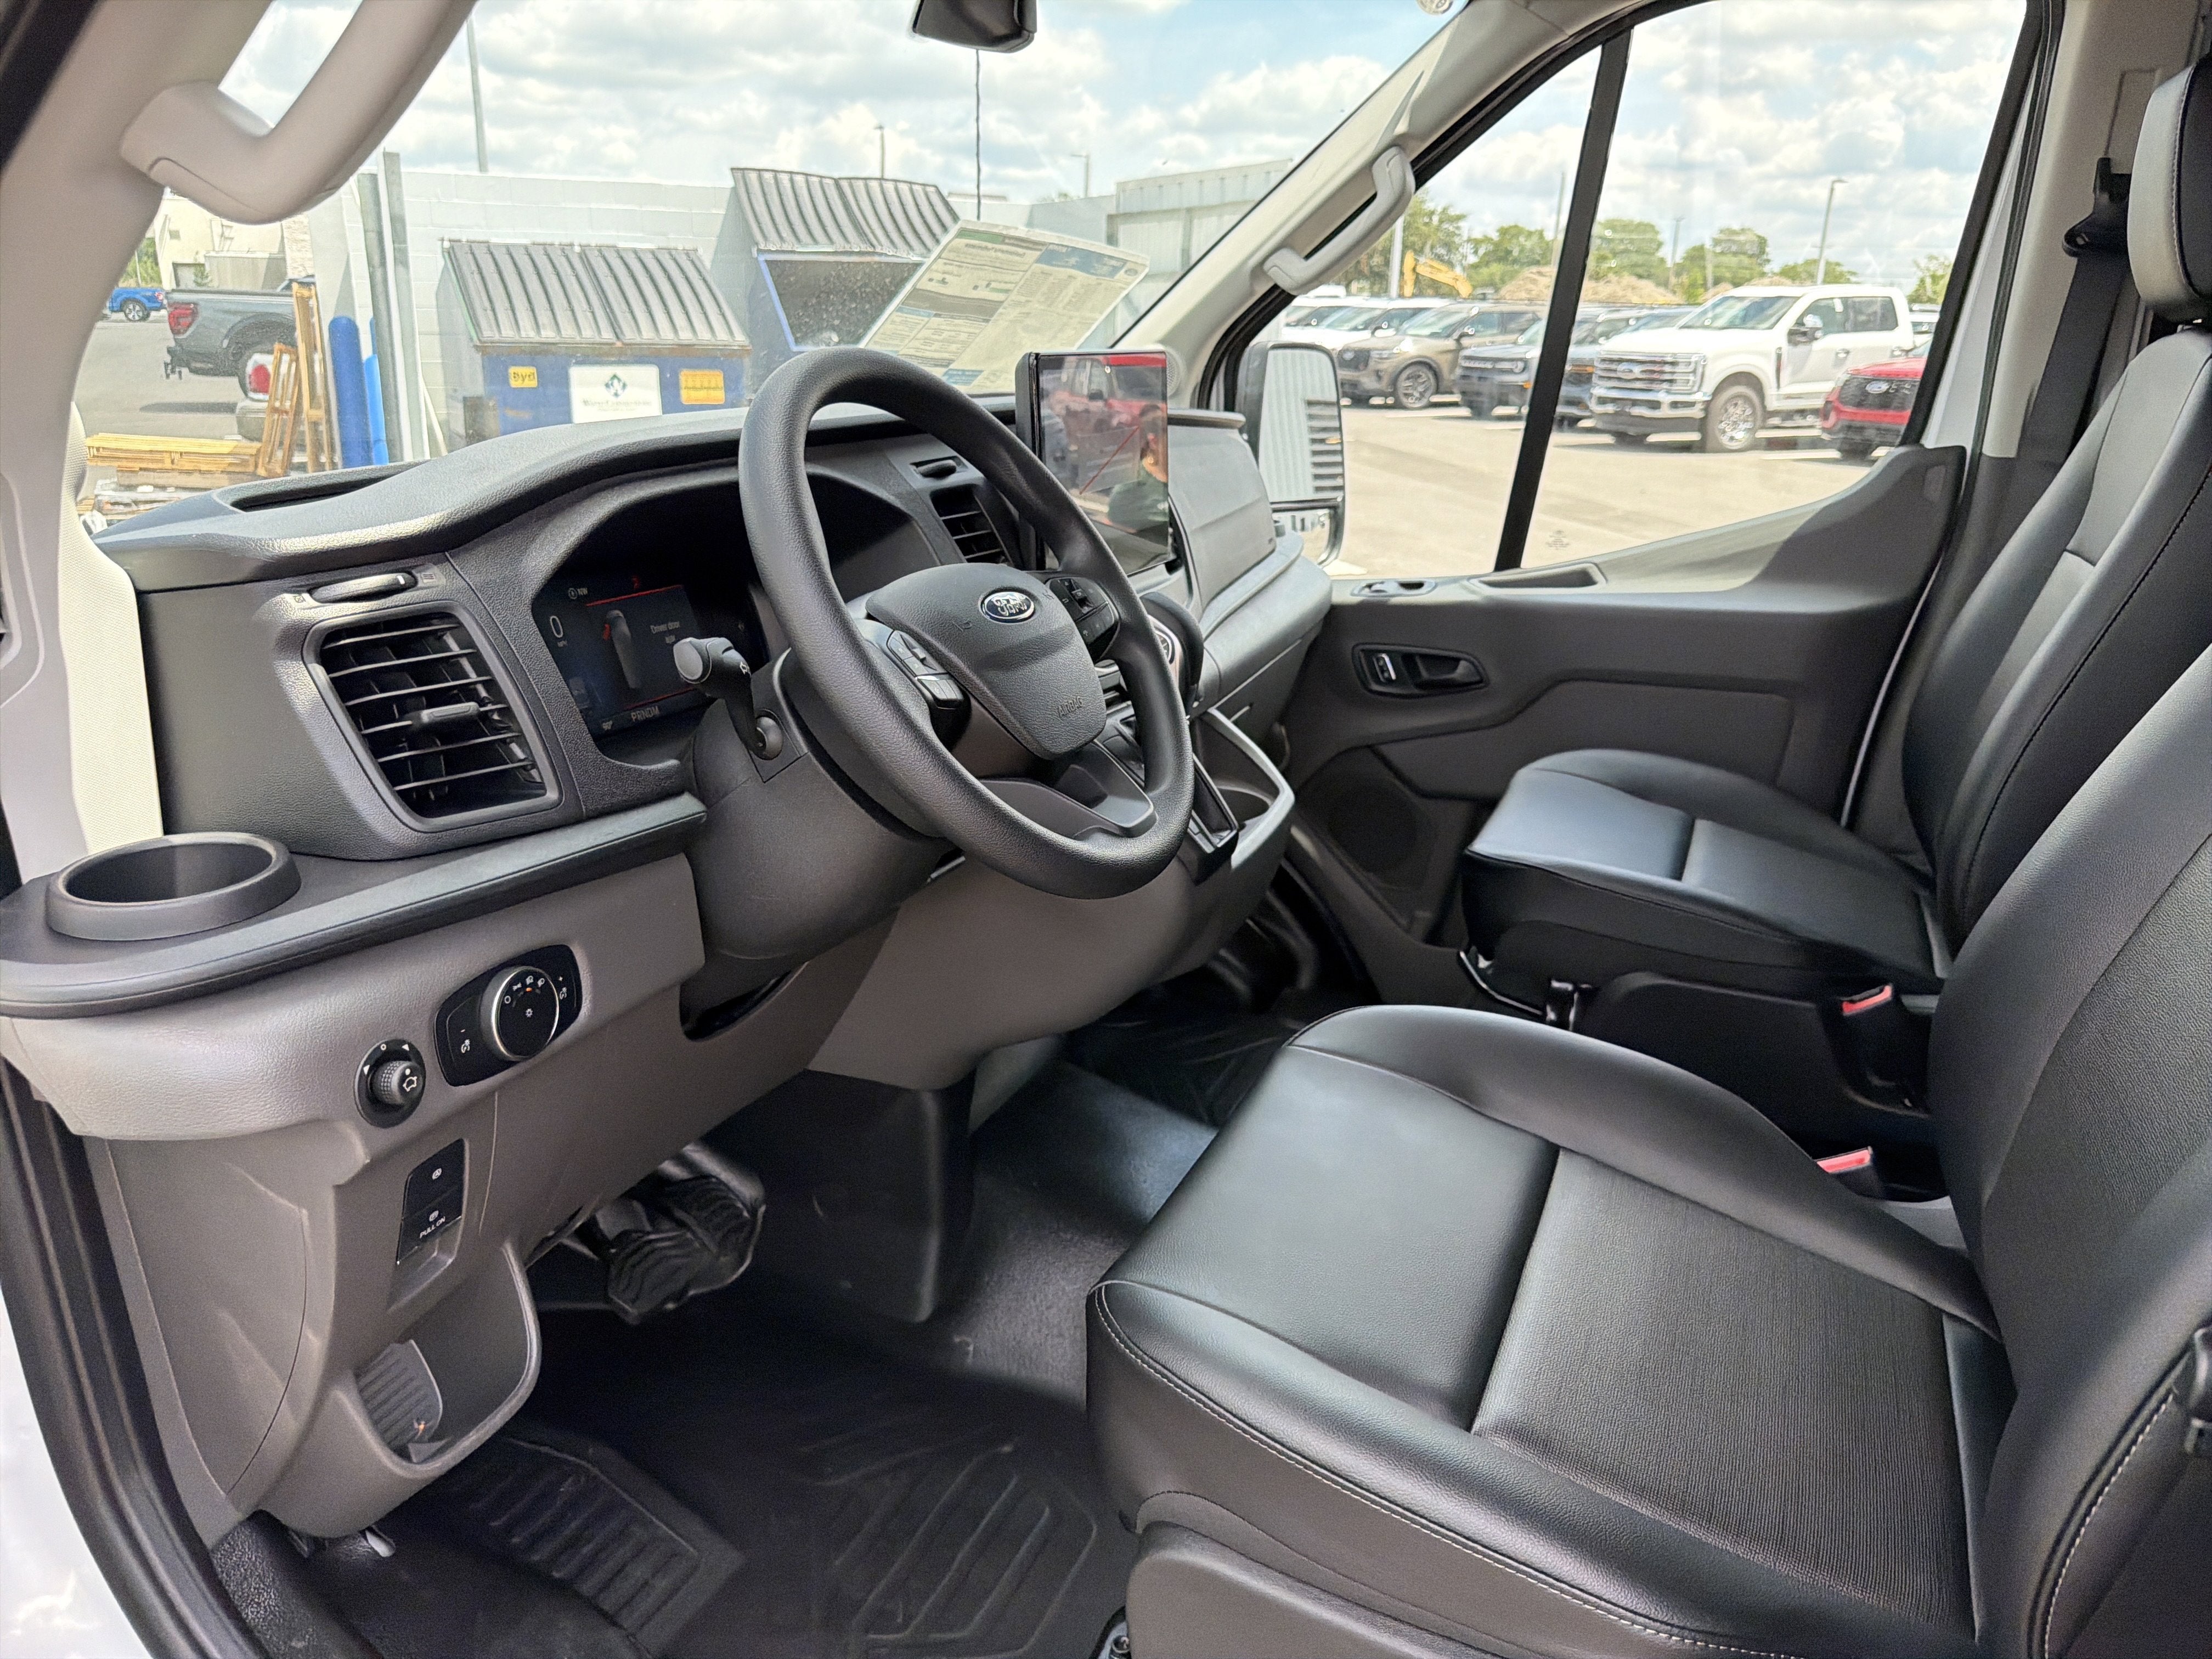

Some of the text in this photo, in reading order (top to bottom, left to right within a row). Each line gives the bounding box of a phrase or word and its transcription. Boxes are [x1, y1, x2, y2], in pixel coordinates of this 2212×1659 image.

[991, 595, 1028, 617] Ford
[550, 616, 563, 638] 0
[1058, 695, 1084, 718] AIRBAG
[420, 1216, 445, 1238] PULL ON
